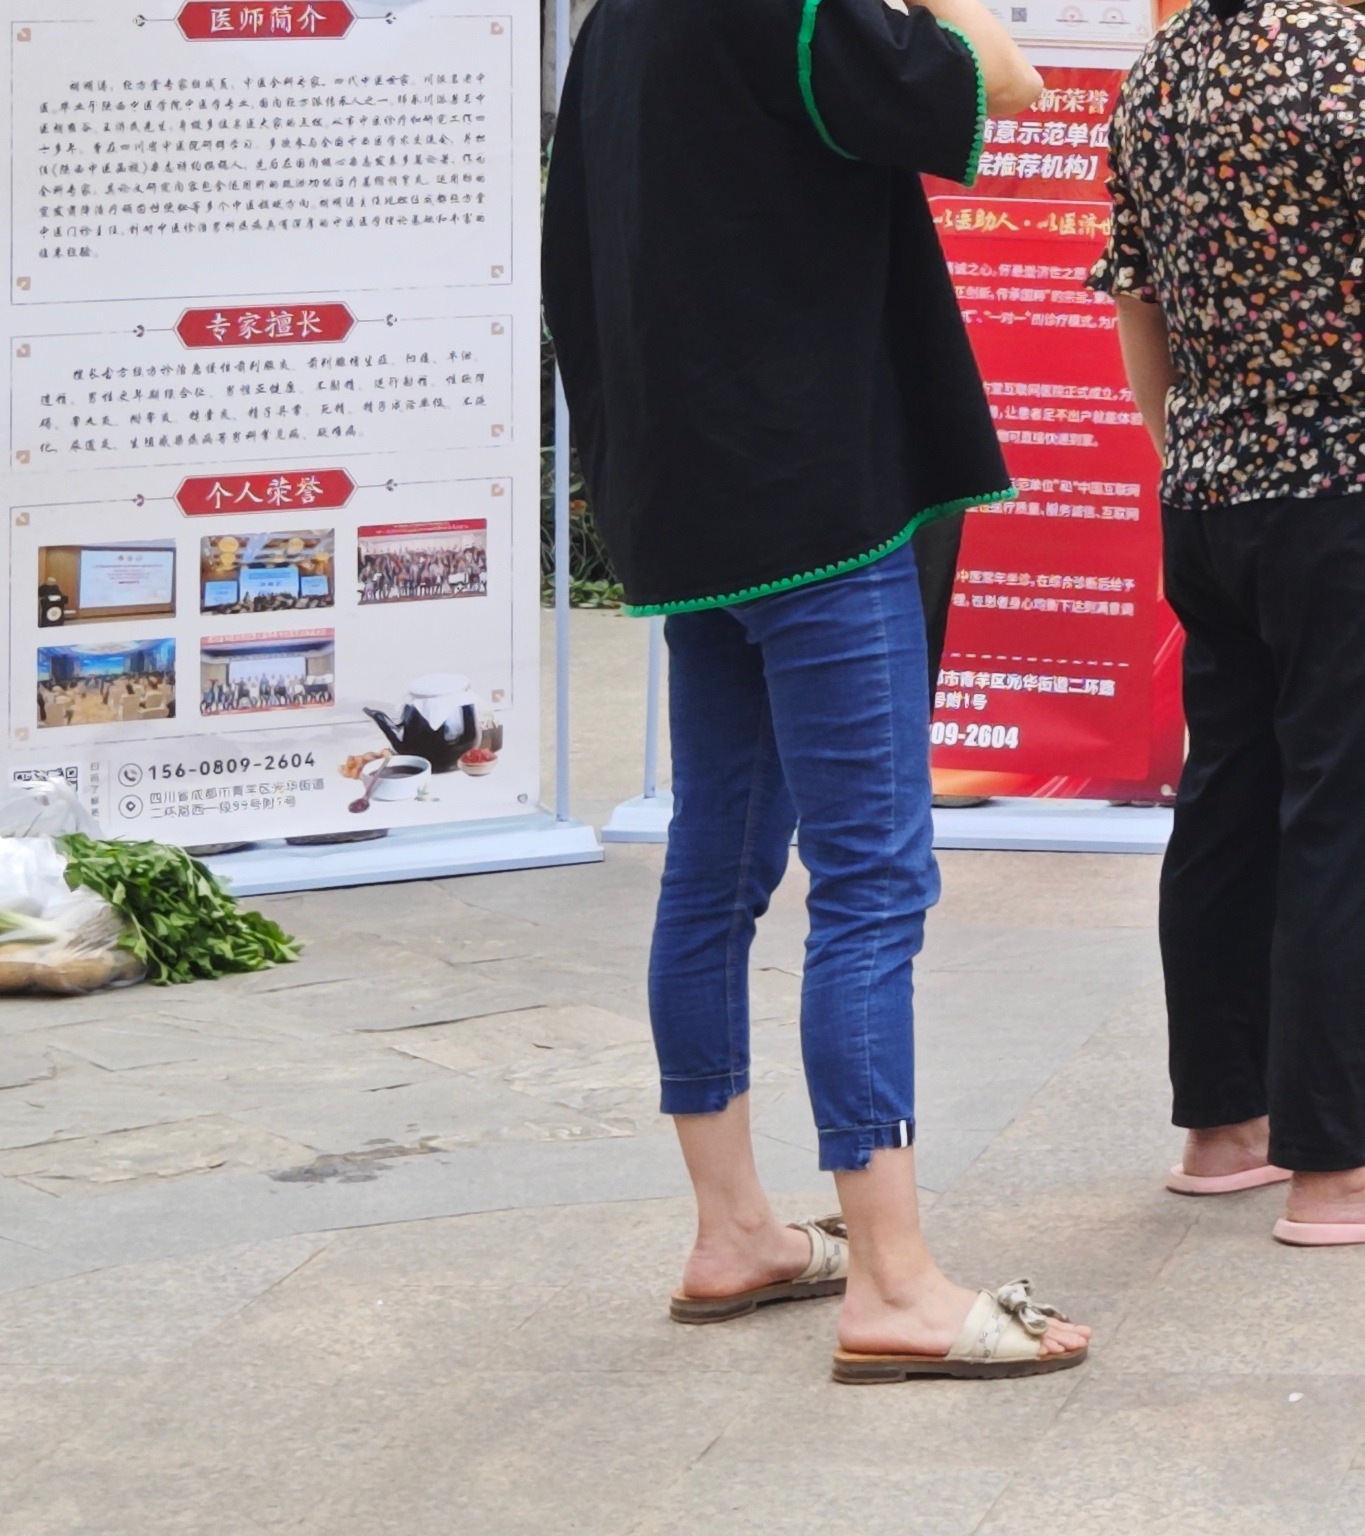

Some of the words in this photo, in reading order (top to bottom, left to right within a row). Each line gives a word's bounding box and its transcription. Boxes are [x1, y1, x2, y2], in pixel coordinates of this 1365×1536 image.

[209, 4, 327, 35] 医师简介
[1030, 87, 1110, 114] 新荣誉
[206, 310, 324, 343] 专家擅长
[205, 472, 324, 510] 个人荣誉
[148, 751, 317, 781] 156-0809-2604
